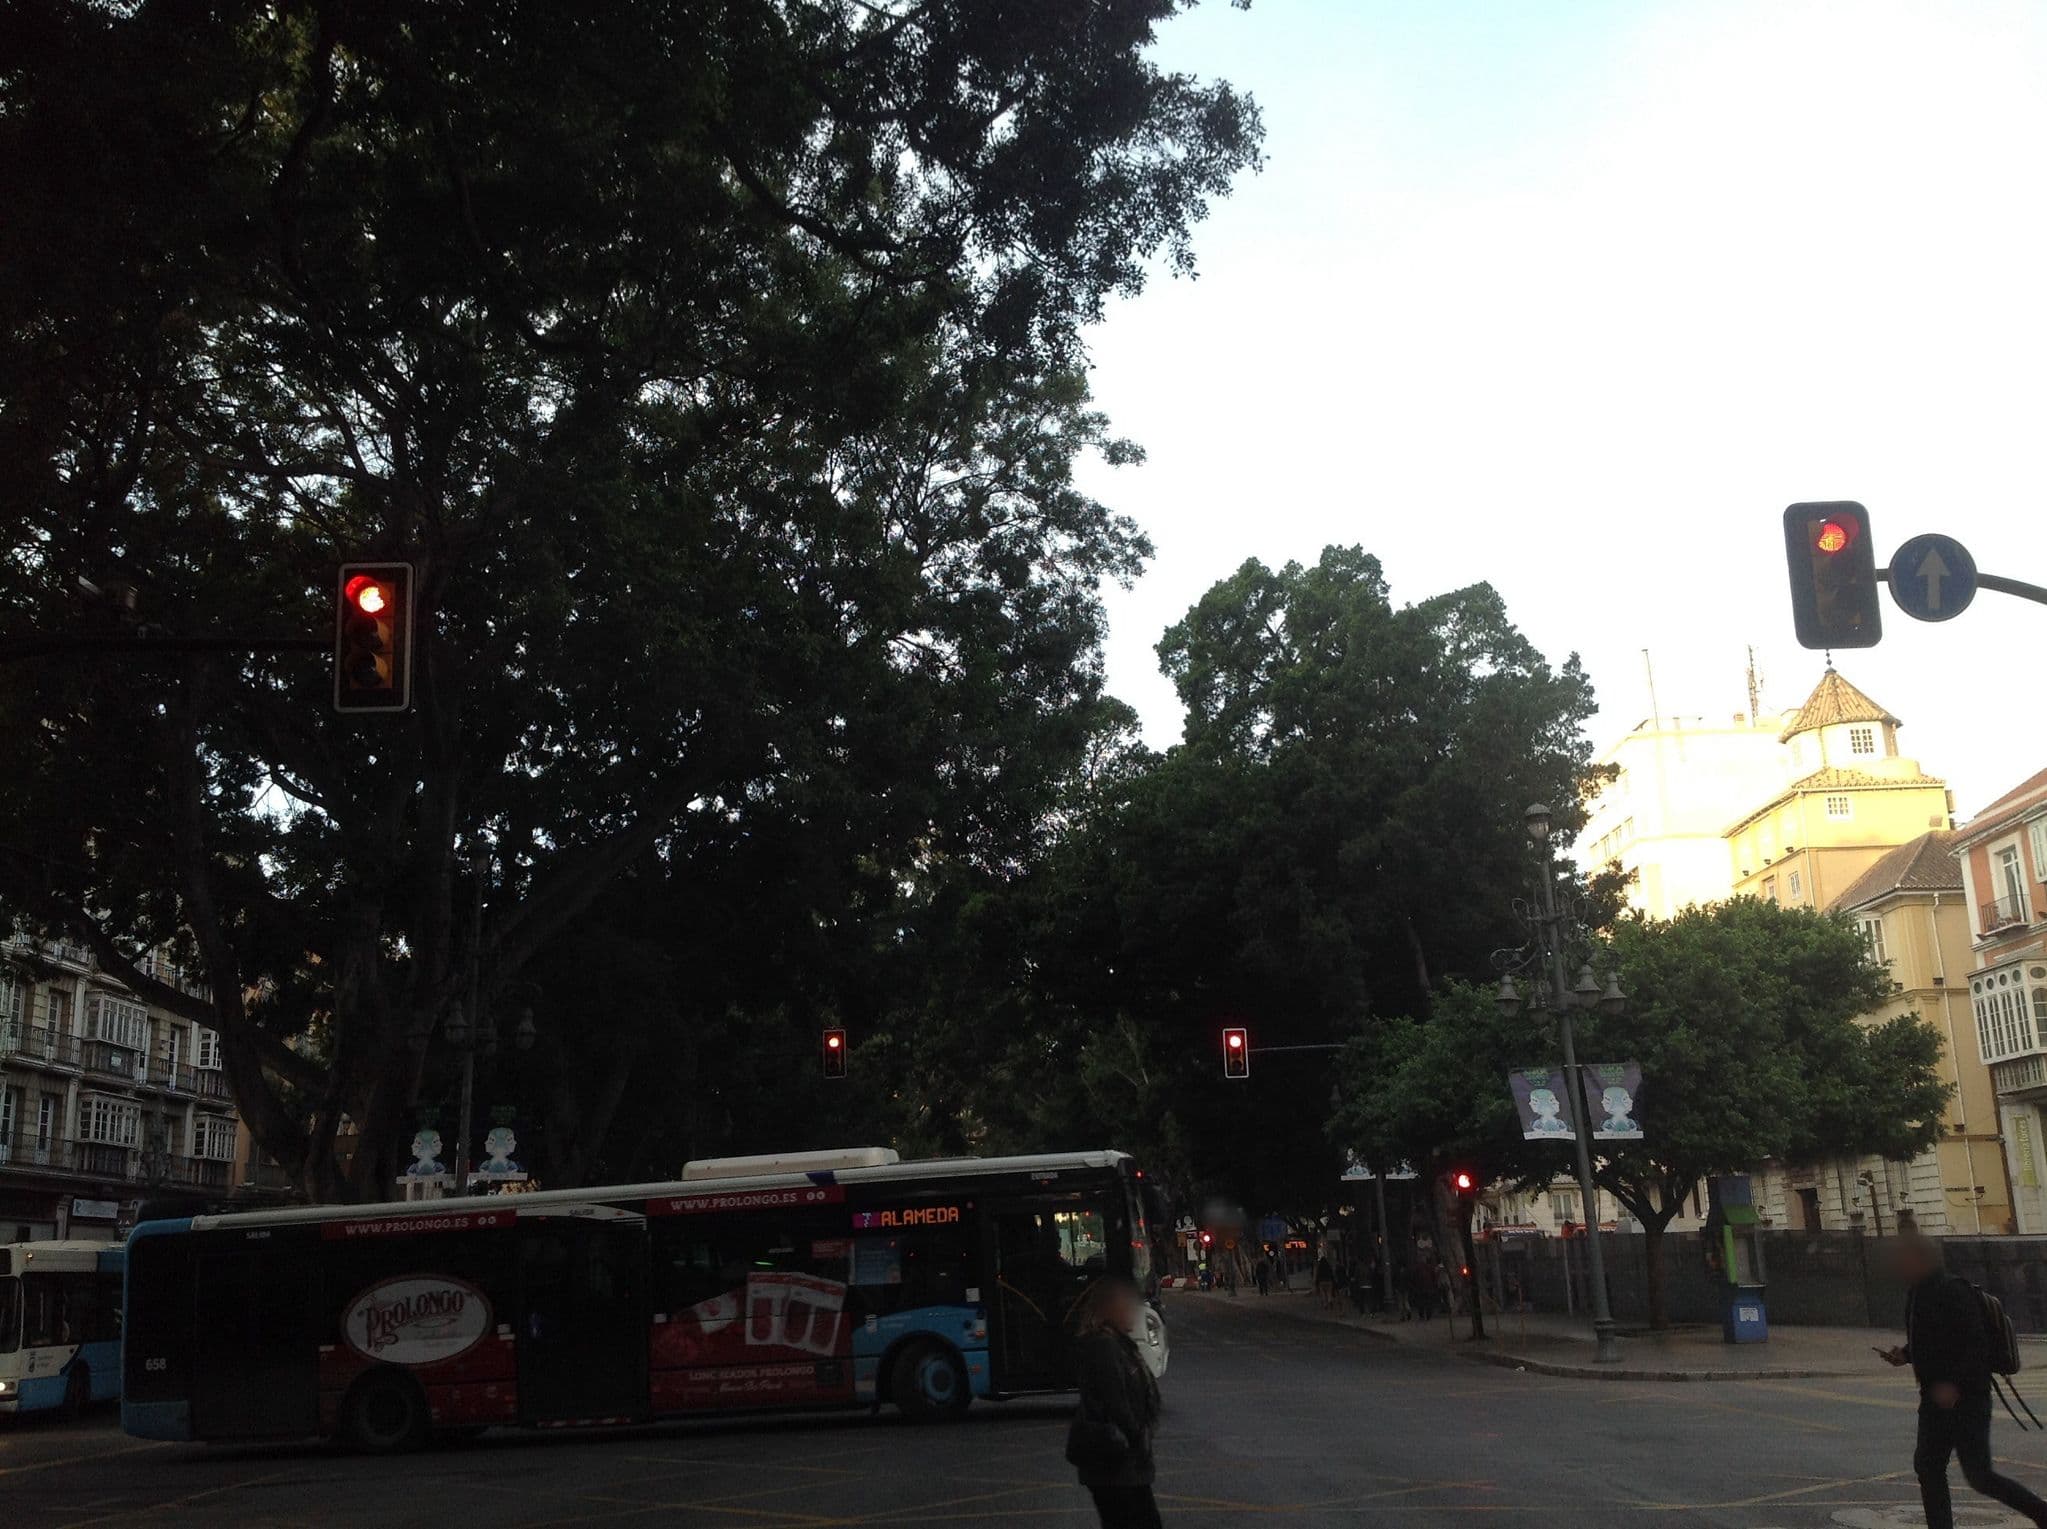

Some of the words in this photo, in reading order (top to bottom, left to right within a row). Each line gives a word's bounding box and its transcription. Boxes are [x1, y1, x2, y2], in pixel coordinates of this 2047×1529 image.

[671, 1193, 798, 1210] WWW.PROLONGO.ES
[881, 1207, 959, 1227] ALAMEDA
[345, 1217, 470, 1235] WWW.PROLONGO.ES
[146, 1358, 167, 1371] 658
